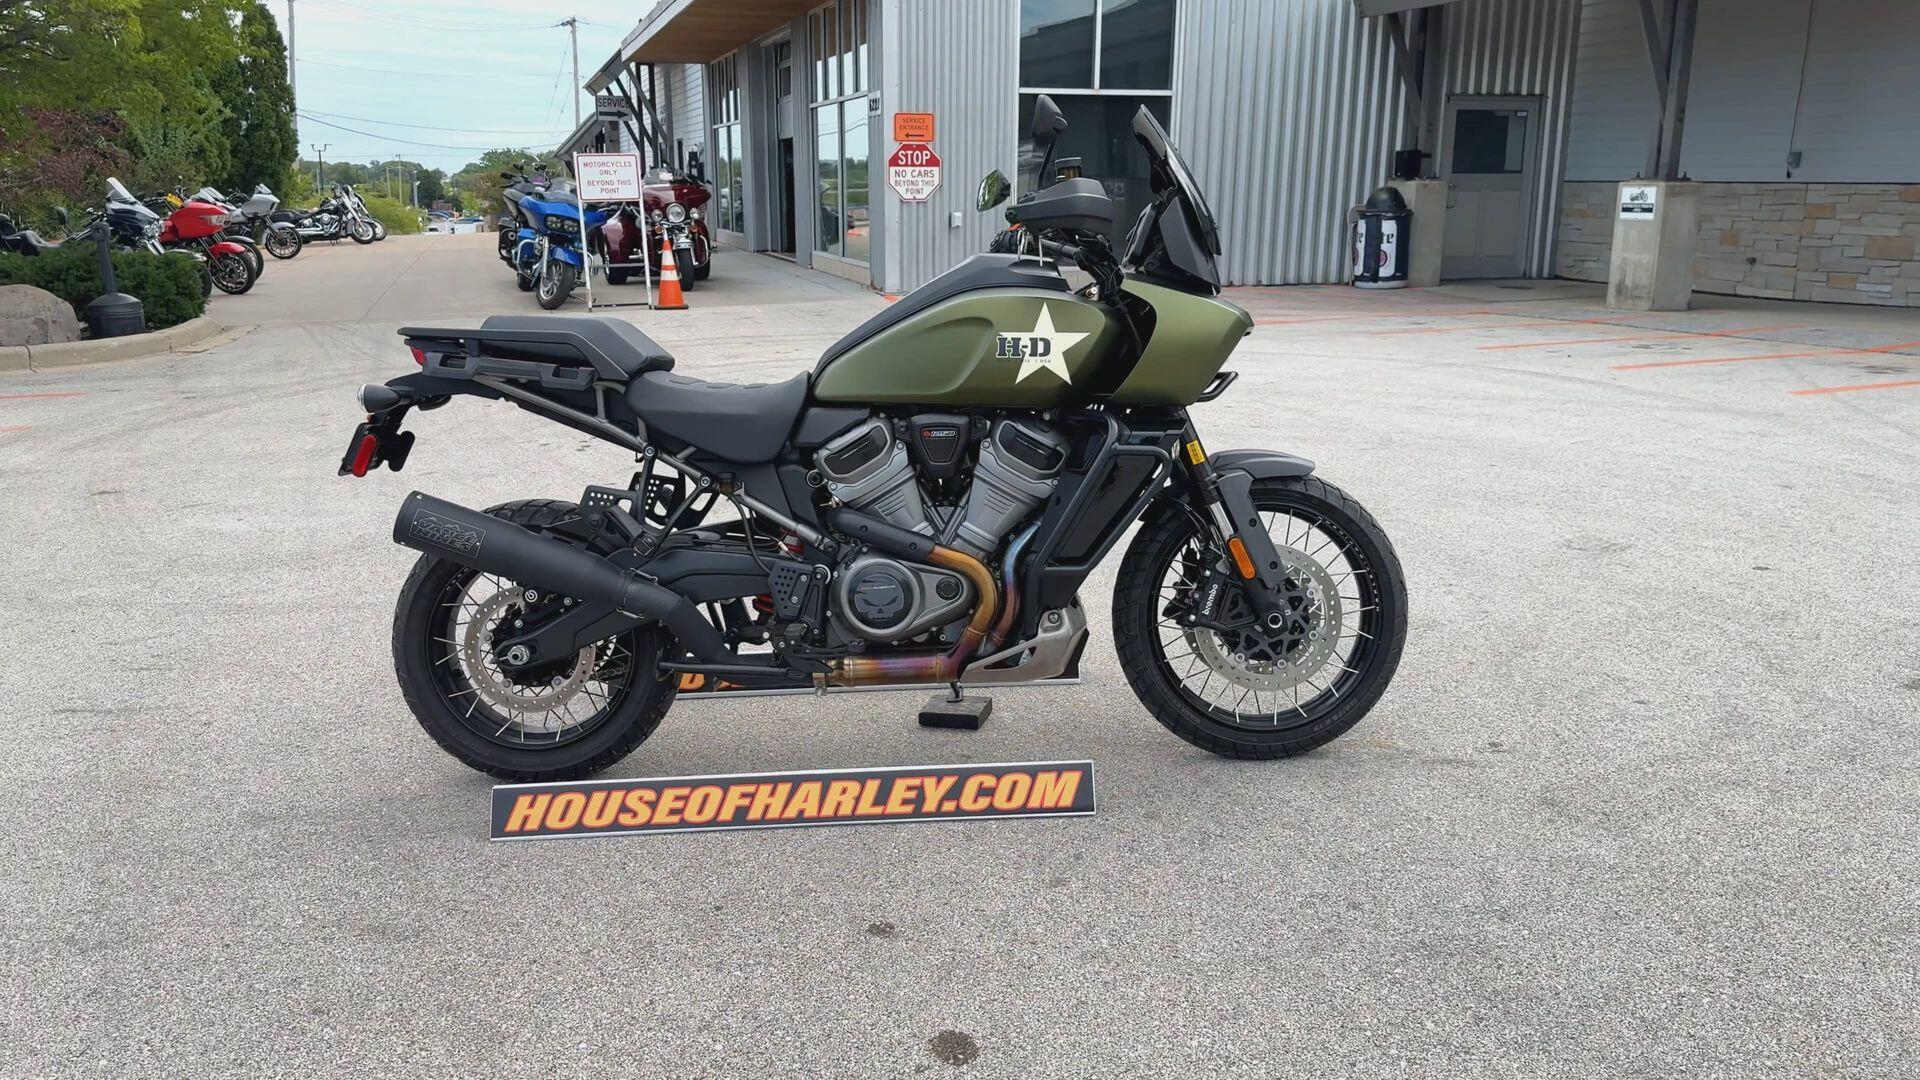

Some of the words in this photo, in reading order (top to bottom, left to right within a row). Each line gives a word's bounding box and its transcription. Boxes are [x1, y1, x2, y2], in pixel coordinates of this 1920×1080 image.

[898, 150, 931, 165] STOP
[894, 169, 907, 178] NO
[911, 169, 935, 178] CARS
[996, 336, 1052, 358] H-D
[1201, 583, 1218, 615] brembo
[503, 770, 1083, 832] HOUSEOFHARLEY.COM
